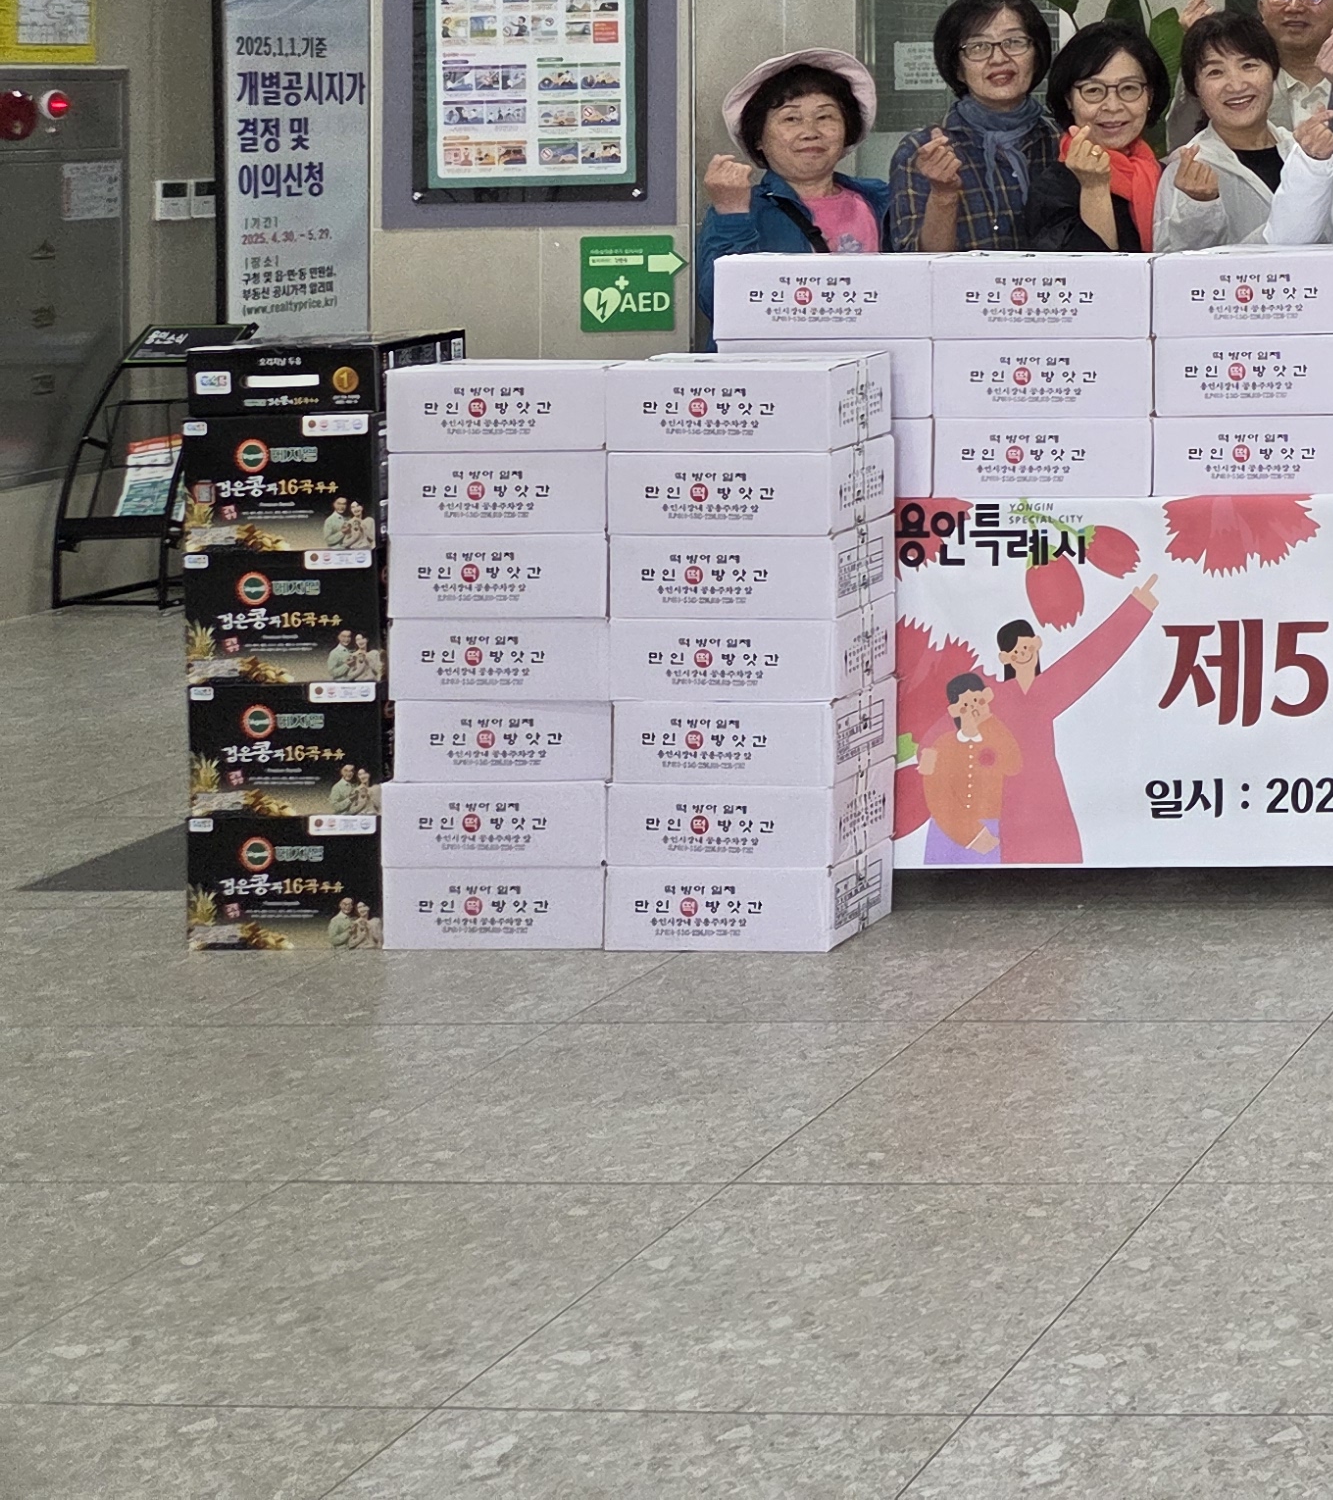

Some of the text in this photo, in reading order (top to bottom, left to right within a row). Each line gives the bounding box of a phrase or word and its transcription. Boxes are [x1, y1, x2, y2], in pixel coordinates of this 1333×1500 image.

[236, 71, 366, 106] 개별공시지가
[237, 117, 310, 153] 결정 및
[238, 161, 324, 199] 이의신청
[619, 291, 670, 313] AED
[1008, 503, 1054, 512] YONGIN
[1008, 514, 1084, 525] SPECIAL CITY
[895, 502, 1087, 567] 용인특례시
[1145, 779, 1225, 820] 일시
